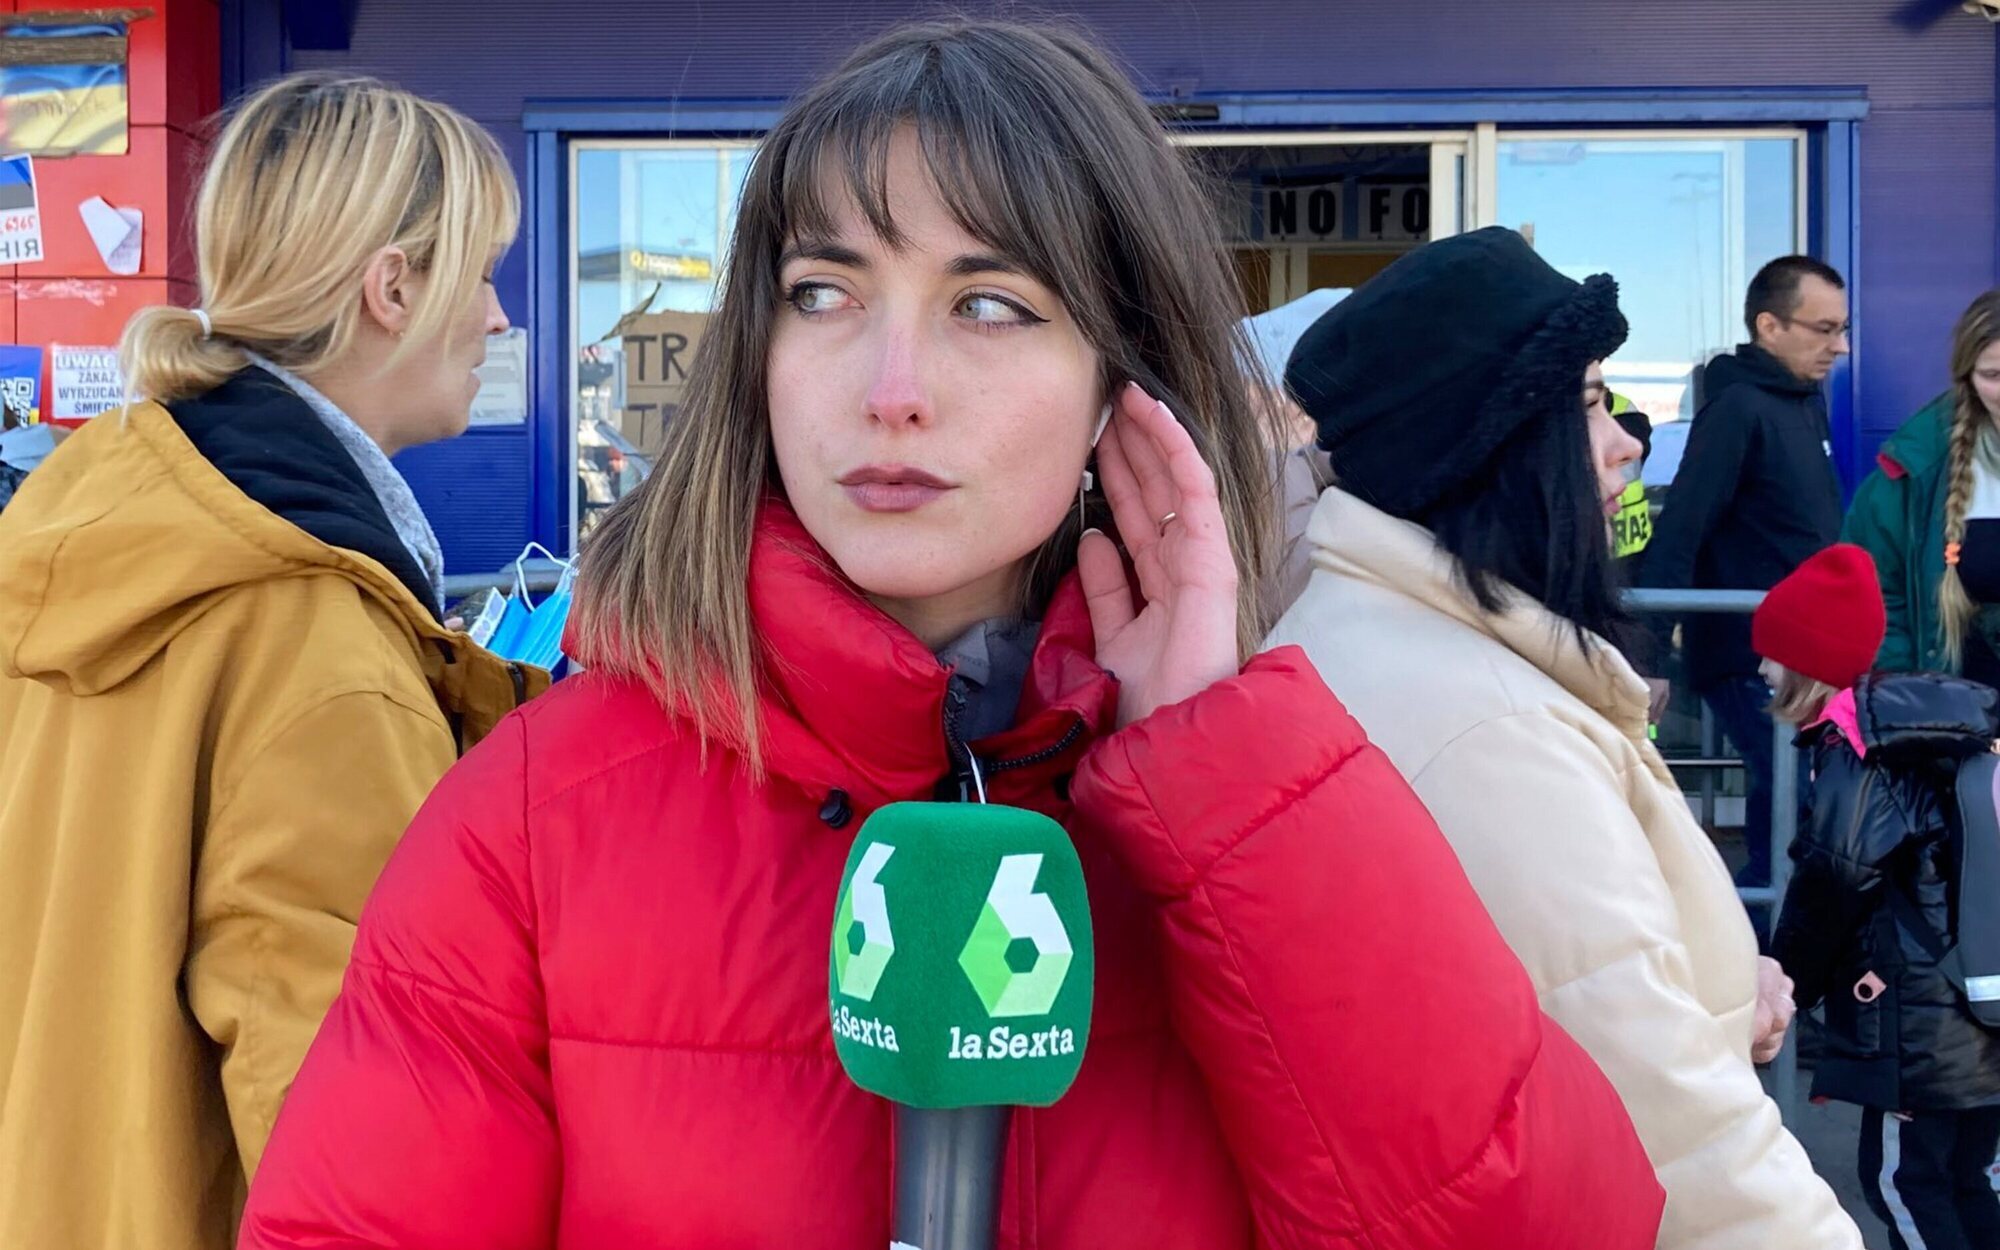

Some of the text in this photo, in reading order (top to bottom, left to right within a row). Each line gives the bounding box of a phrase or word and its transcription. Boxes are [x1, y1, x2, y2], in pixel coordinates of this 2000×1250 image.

[1269, 189, 1336, 236] NO
[78, 371, 116, 384] ZAKAZ
[58, 387, 124, 399] WYRZUCAN
